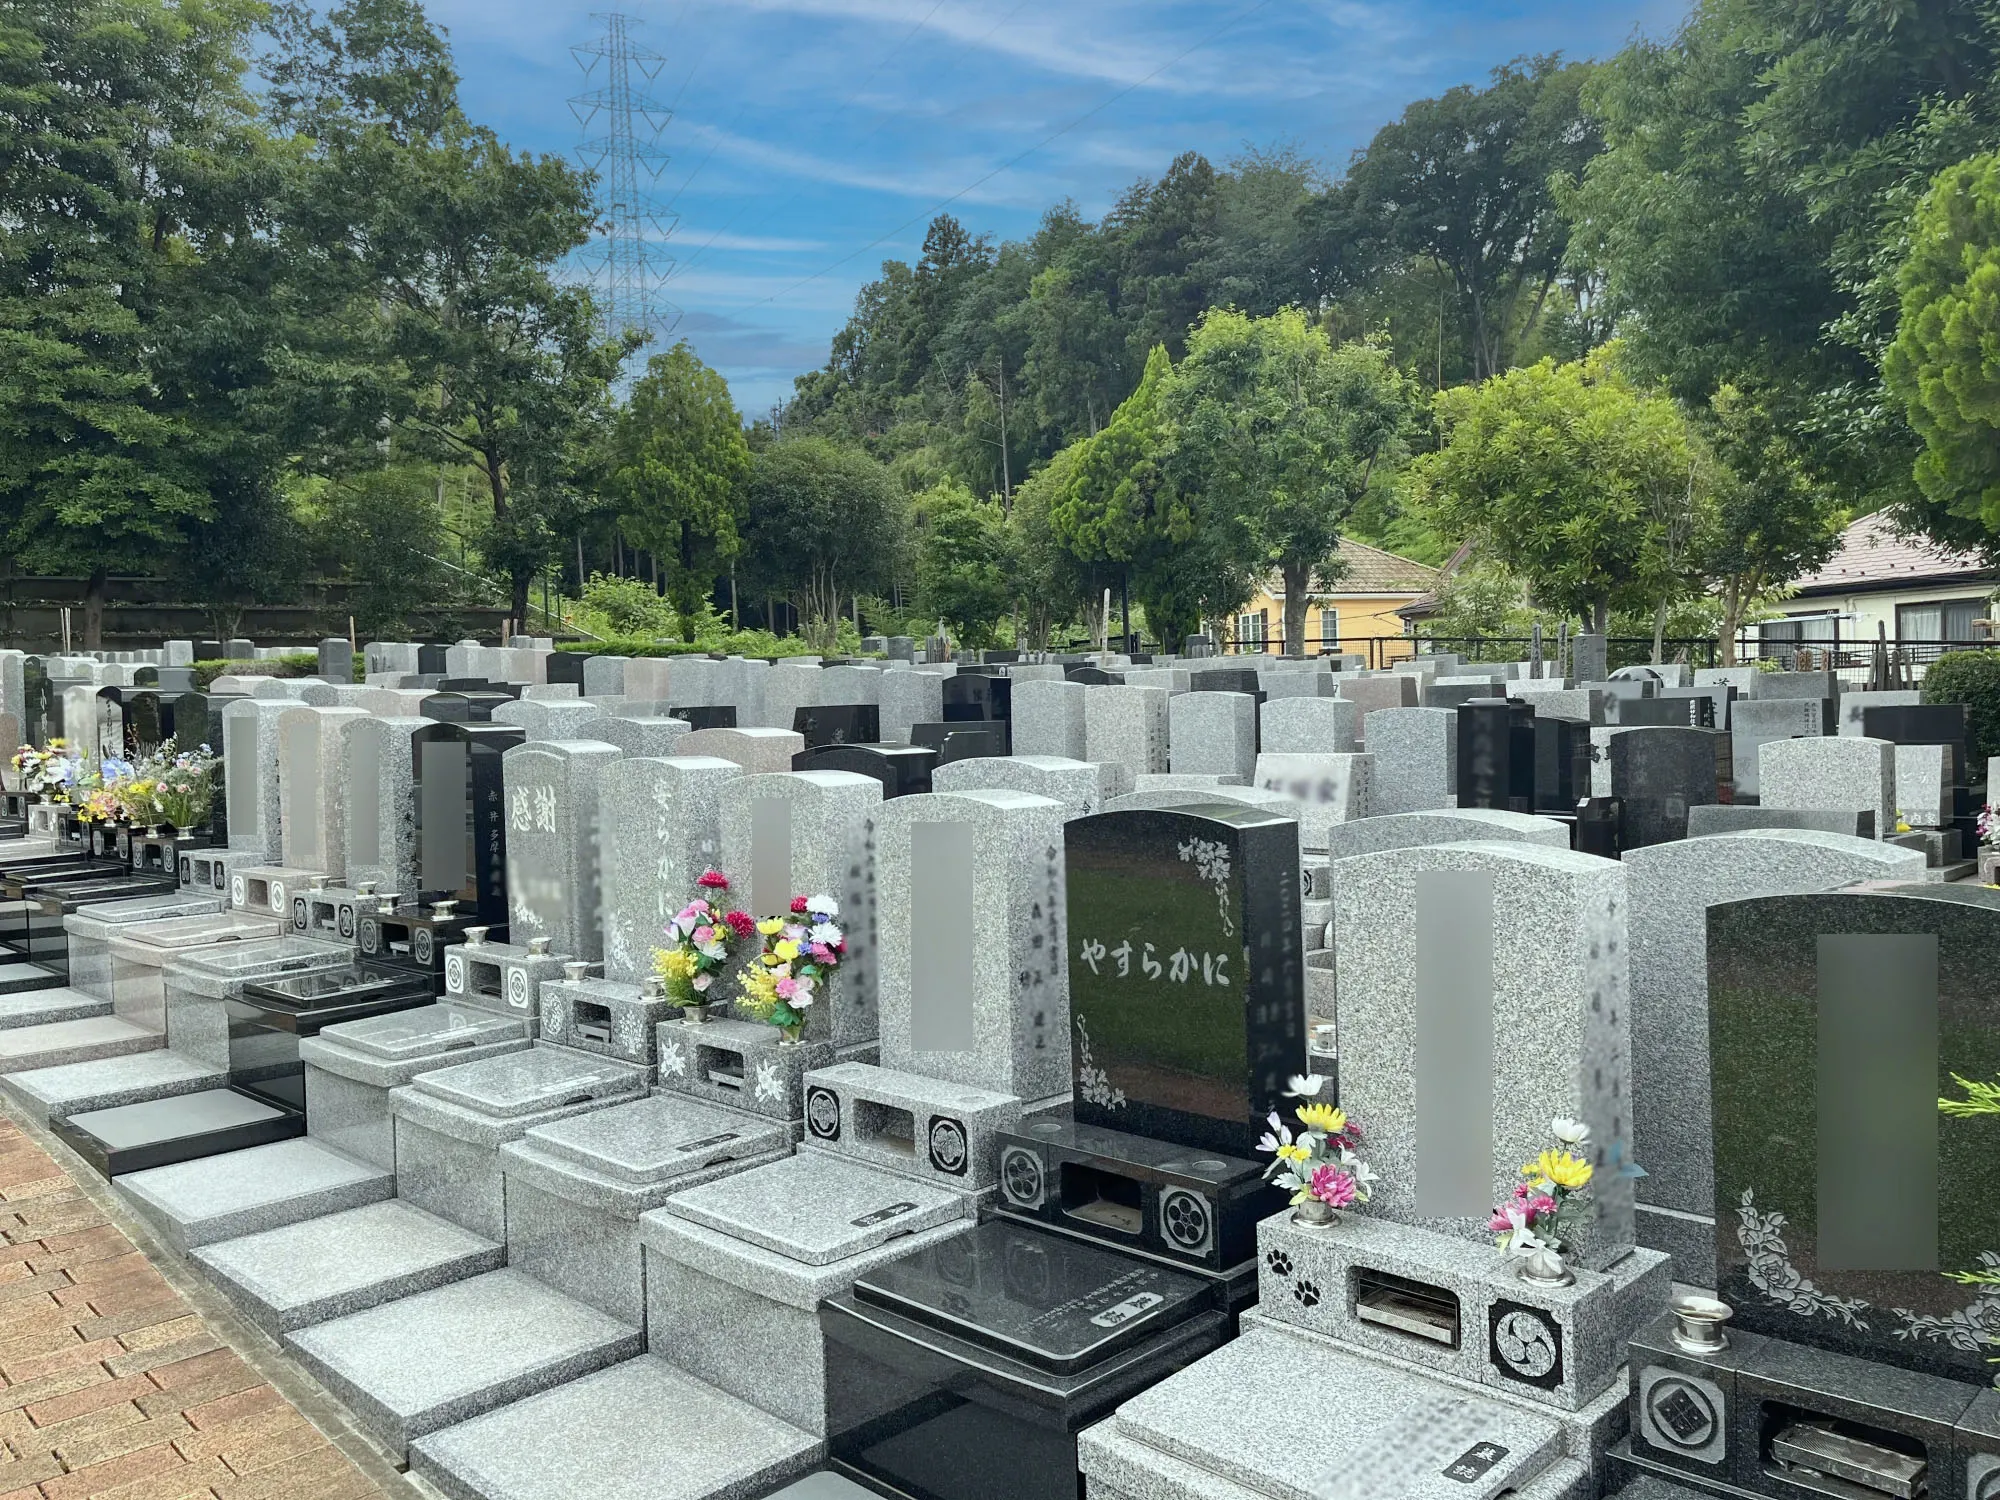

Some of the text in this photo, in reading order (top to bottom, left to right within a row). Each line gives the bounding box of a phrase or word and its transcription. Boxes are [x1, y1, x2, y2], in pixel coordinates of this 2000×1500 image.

[512, 784, 556, 833] 感謝
[1080, 938, 1230, 986] やすらかに
